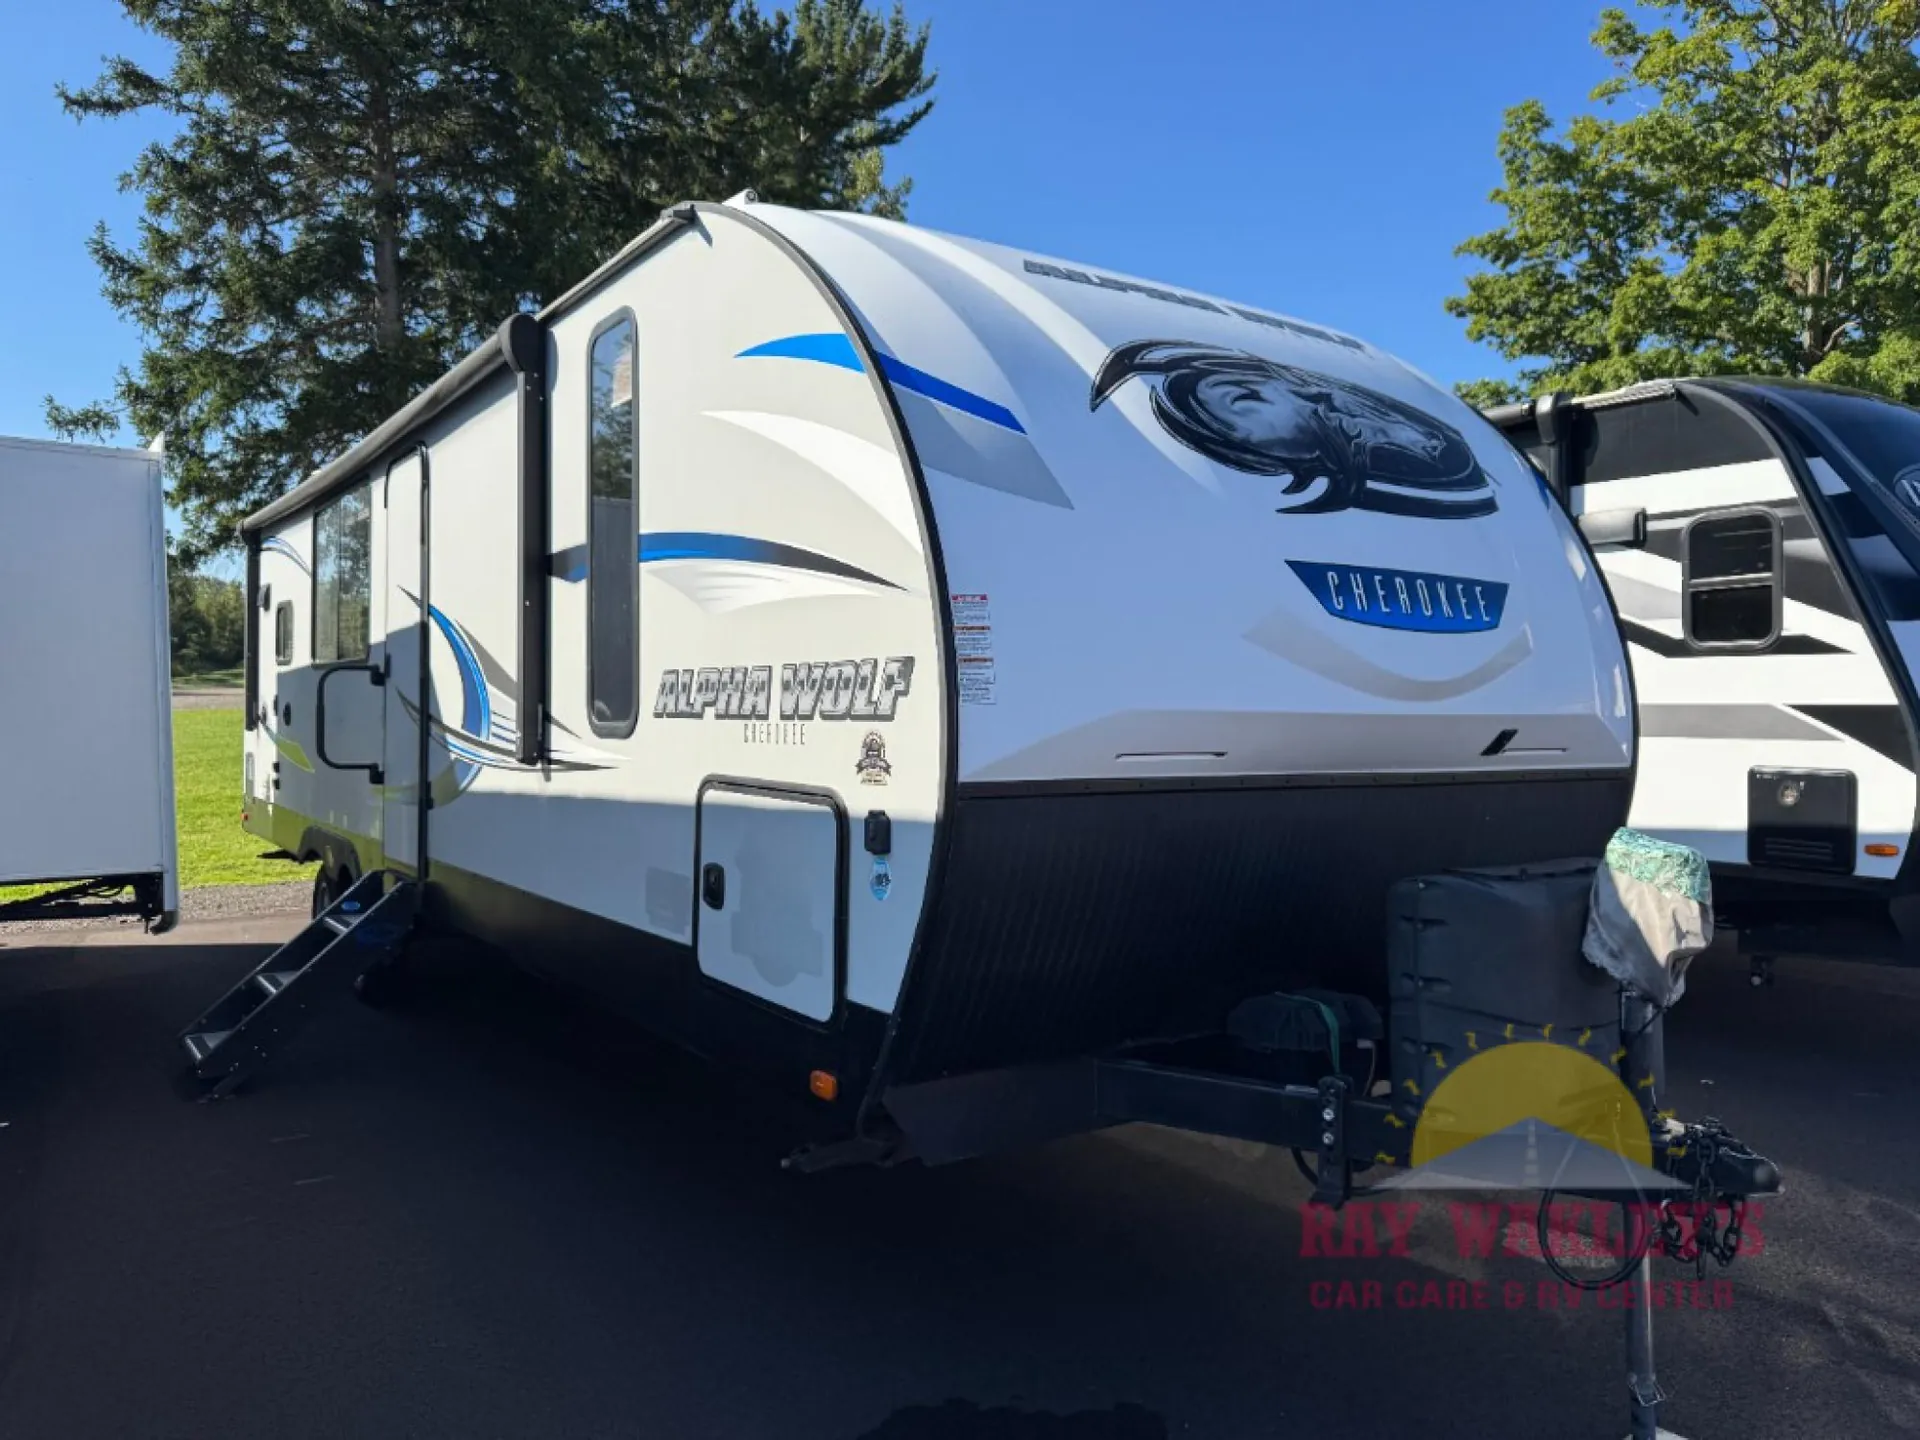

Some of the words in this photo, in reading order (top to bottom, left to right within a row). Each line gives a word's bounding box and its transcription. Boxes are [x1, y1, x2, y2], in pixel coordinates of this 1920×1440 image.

[1326, 571, 1492, 622] CHEROKEE
[653, 665, 773, 720] ALPHA
[780, 656, 915, 721] WOLF
